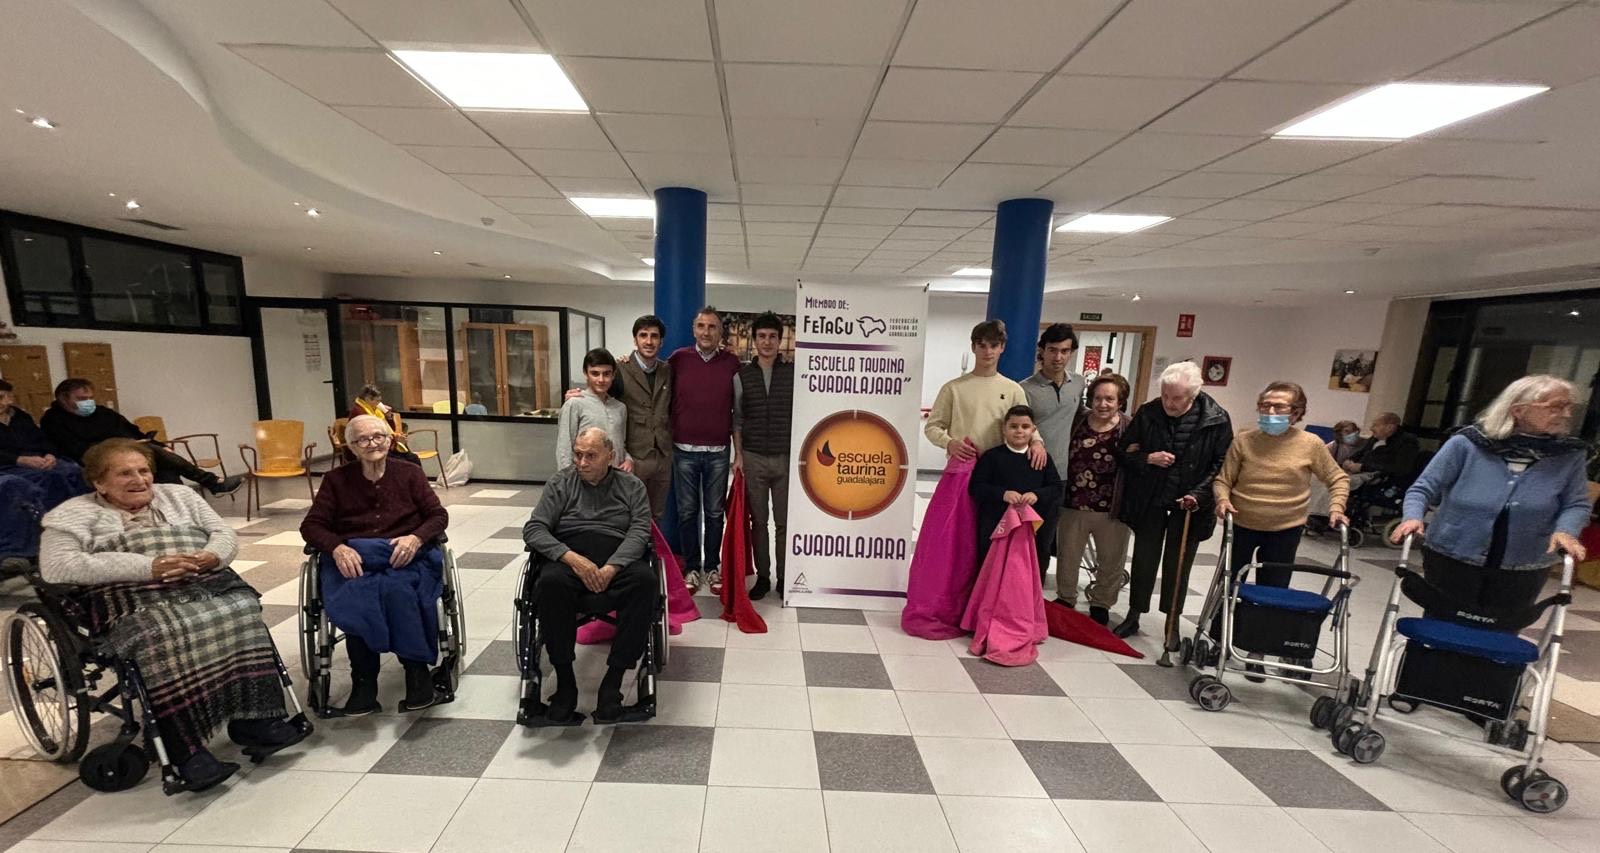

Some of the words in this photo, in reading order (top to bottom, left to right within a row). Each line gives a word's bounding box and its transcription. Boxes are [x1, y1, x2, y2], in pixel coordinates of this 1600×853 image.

[808, 355, 856, 373] ESCUELA
[859, 357, 905, 374] TAURINA
[837, 450, 893, 465] escuela
[837, 463, 886, 476] taurina
[836, 476, 886, 486] guadalajara
[792, 533, 906, 561] GUADALAJARA
